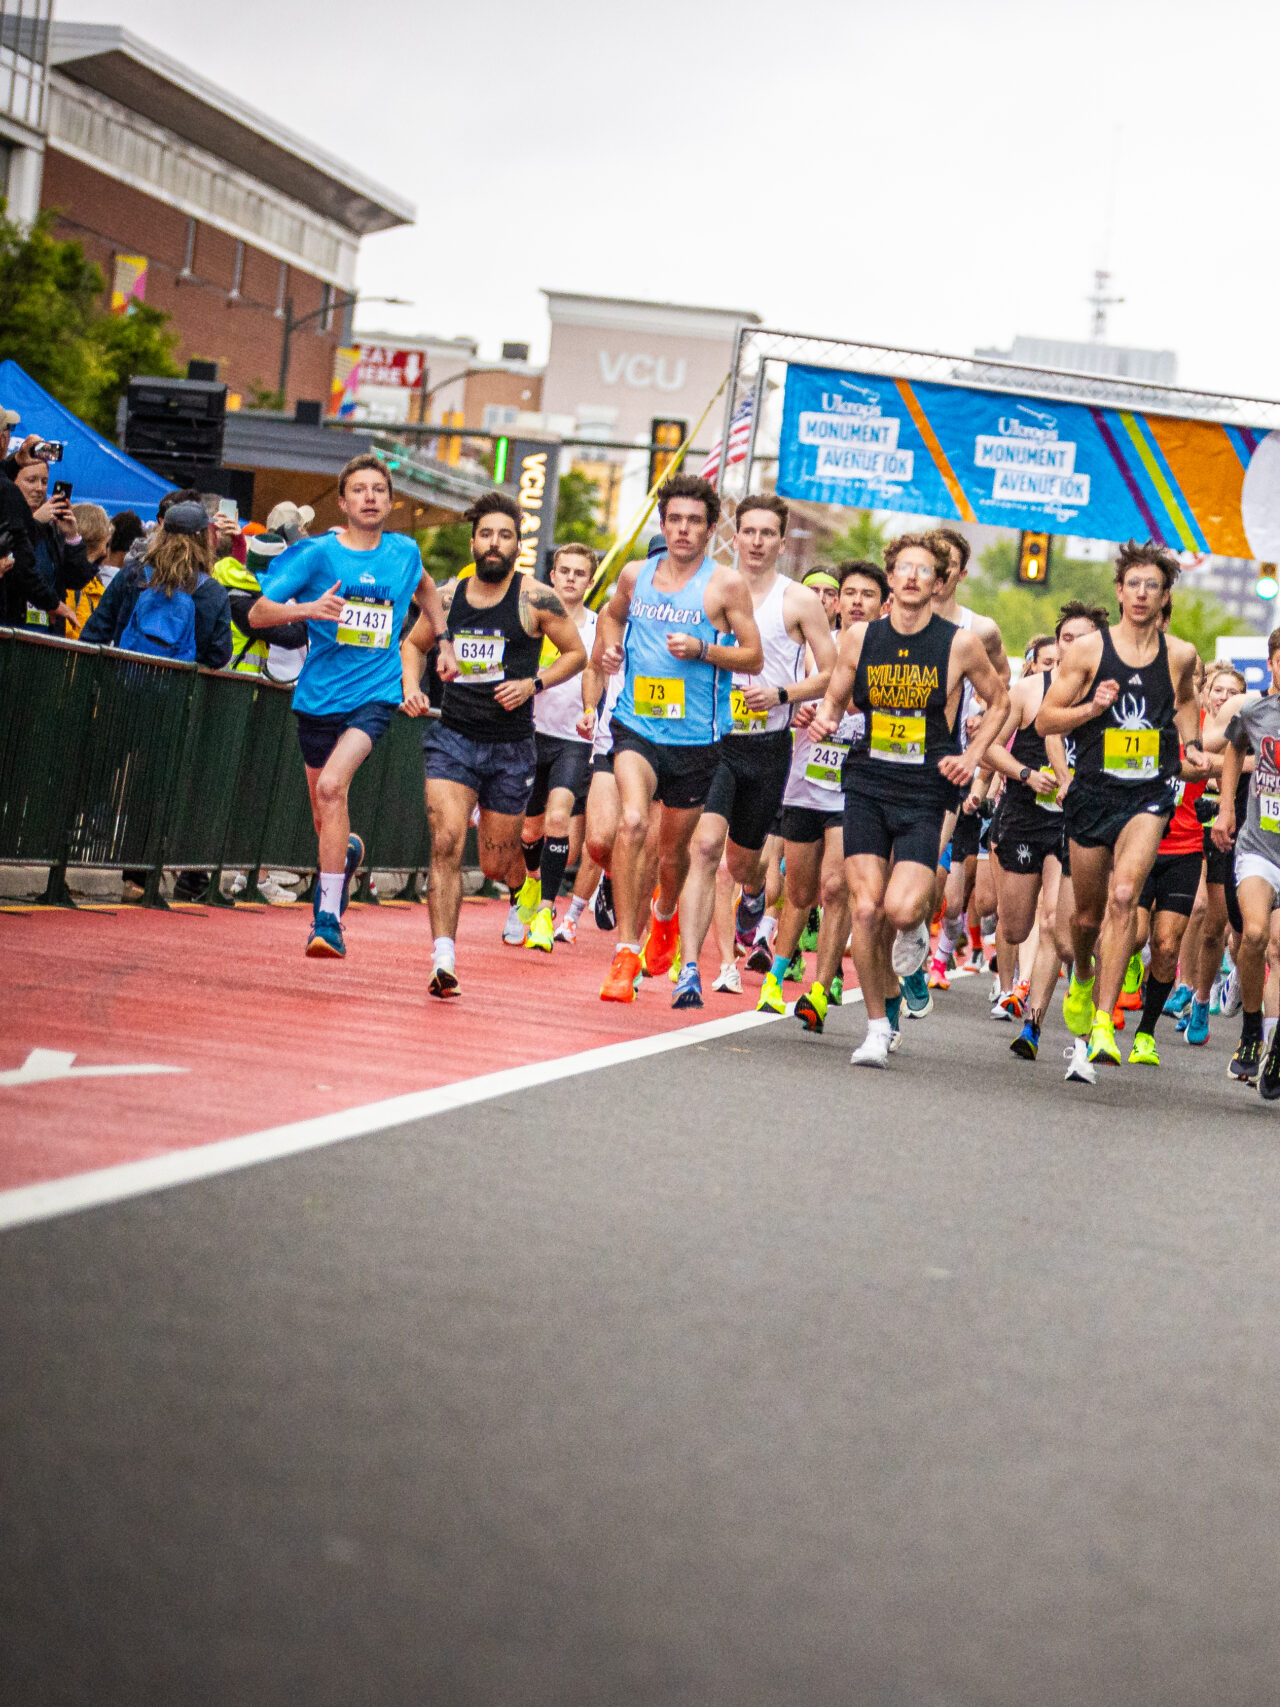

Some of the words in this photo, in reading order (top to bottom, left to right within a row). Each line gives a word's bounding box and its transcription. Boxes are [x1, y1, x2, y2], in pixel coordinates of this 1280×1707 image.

[599, 350, 687, 391] VCU
[806, 420, 890, 444] MONUMENT
[823, 448, 879, 472] AVENUE
[981, 443, 1067, 468] MONUMENT
[519, 452, 548, 509] VCU
[999, 473, 1055, 496] AVENUE
[345, 609, 387, 630] 21437
[631, 598, 702, 625] Brothers
[461, 642, 494, 659] 6344
[867, 663, 939, 688] WILLIAM
[648, 684, 665, 701] 73
[889, 722, 906, 739] 72
[1124, 736, 1140, 753] 71
